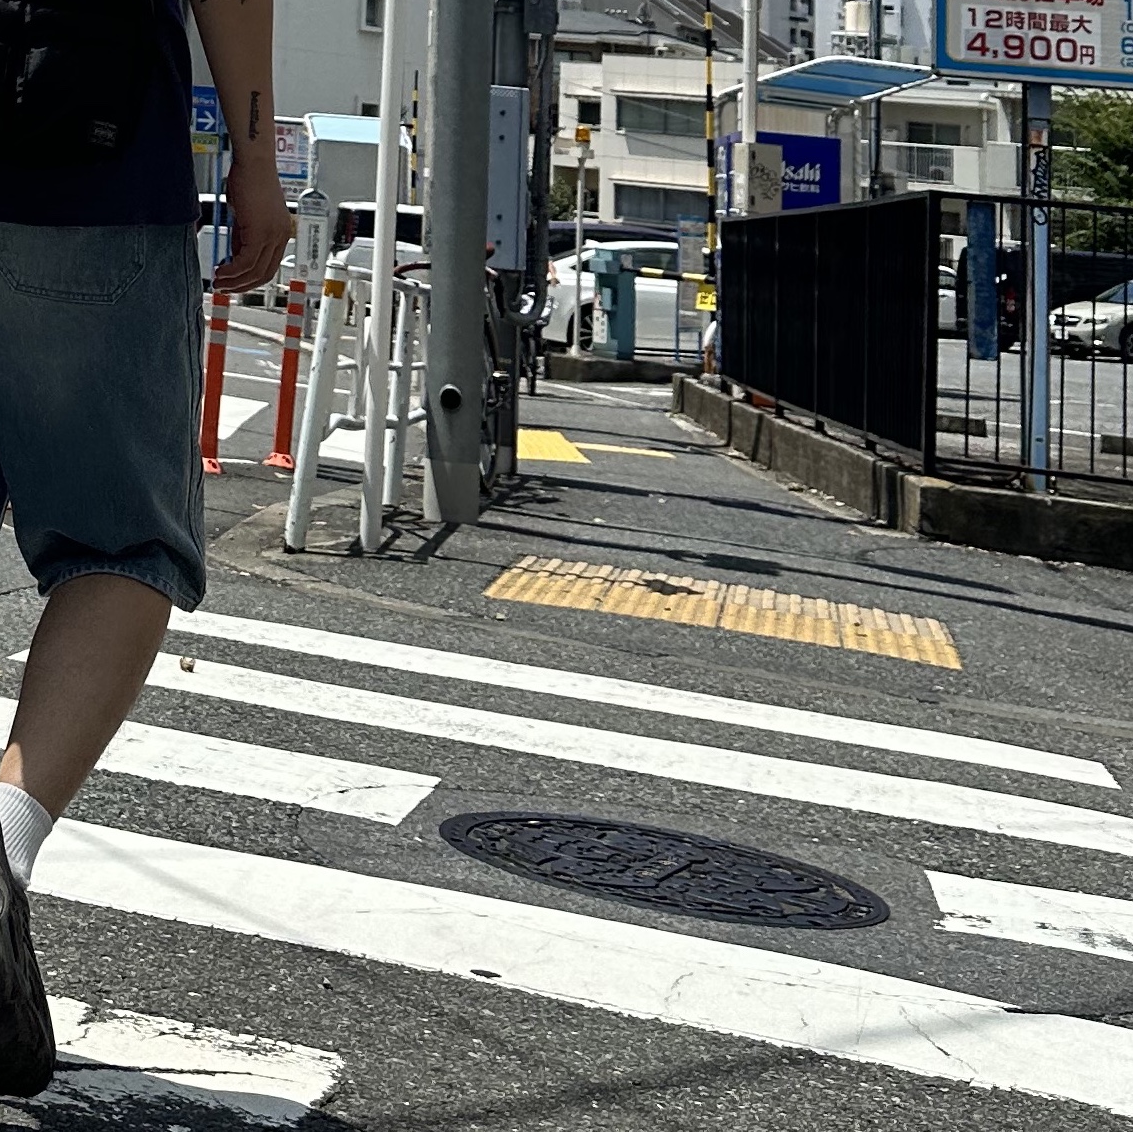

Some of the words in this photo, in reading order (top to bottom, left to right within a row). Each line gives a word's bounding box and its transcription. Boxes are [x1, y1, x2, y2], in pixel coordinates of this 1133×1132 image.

[967, 7, 1093, 34] 12時間最大
[966, 32, 1095, 66] 4,900円
